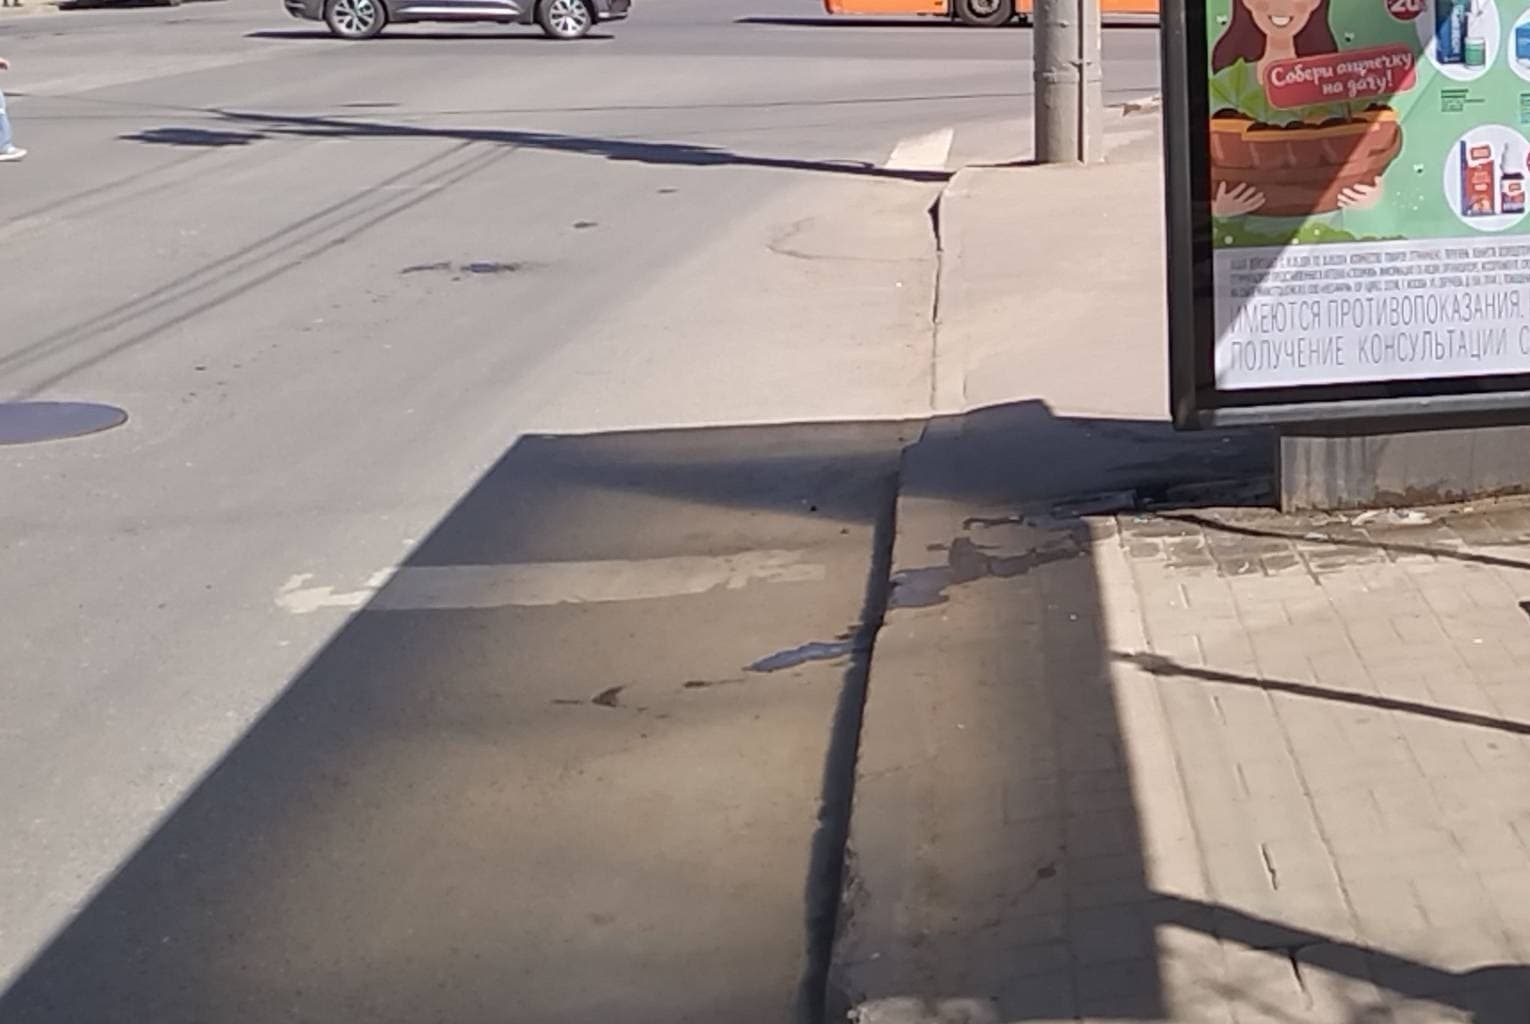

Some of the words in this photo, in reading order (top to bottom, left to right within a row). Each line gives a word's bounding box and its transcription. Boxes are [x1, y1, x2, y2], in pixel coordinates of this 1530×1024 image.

[1271, 63, 1334, 86] Собери
[1322, 81, 1344, 95] на
[1230, 300, 1321, 334] ИМЕЮТСЯ
[1230, 335, 1345, 372] ПОЛУЧЕНИЕ
[1358, 327, 1508, 365] КОНСУЛЬТАЦИИ
